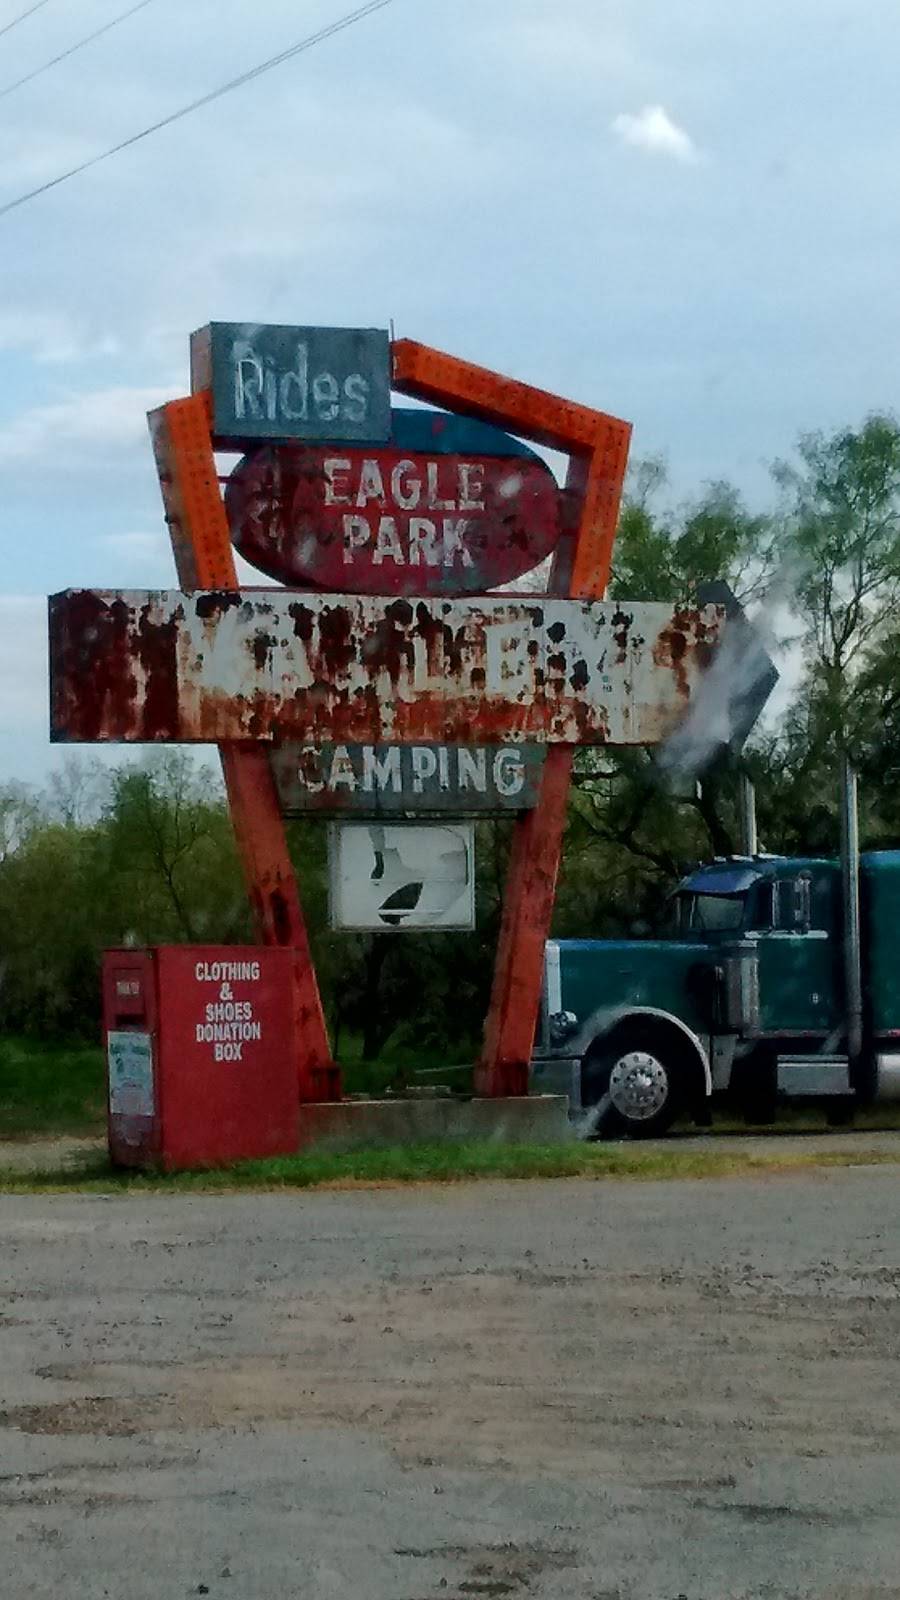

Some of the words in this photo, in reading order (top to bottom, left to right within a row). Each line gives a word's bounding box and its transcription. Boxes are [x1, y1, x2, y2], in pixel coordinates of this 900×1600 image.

[232, 343, 371, 422] Rides
[323, 459, 485, 511] EAGLE
[343, 514, 475, 567] PARK
[299, 745, 526, 795] CAMPING
[195, 961, 260, 981] CLOTHING
[219, 982, 233, 1000] &
[206, 1002, 252, 1022] SHOES
[196, 1022, 261, 1042] DONATION
[214, 1043, 243, 1061] BOX
